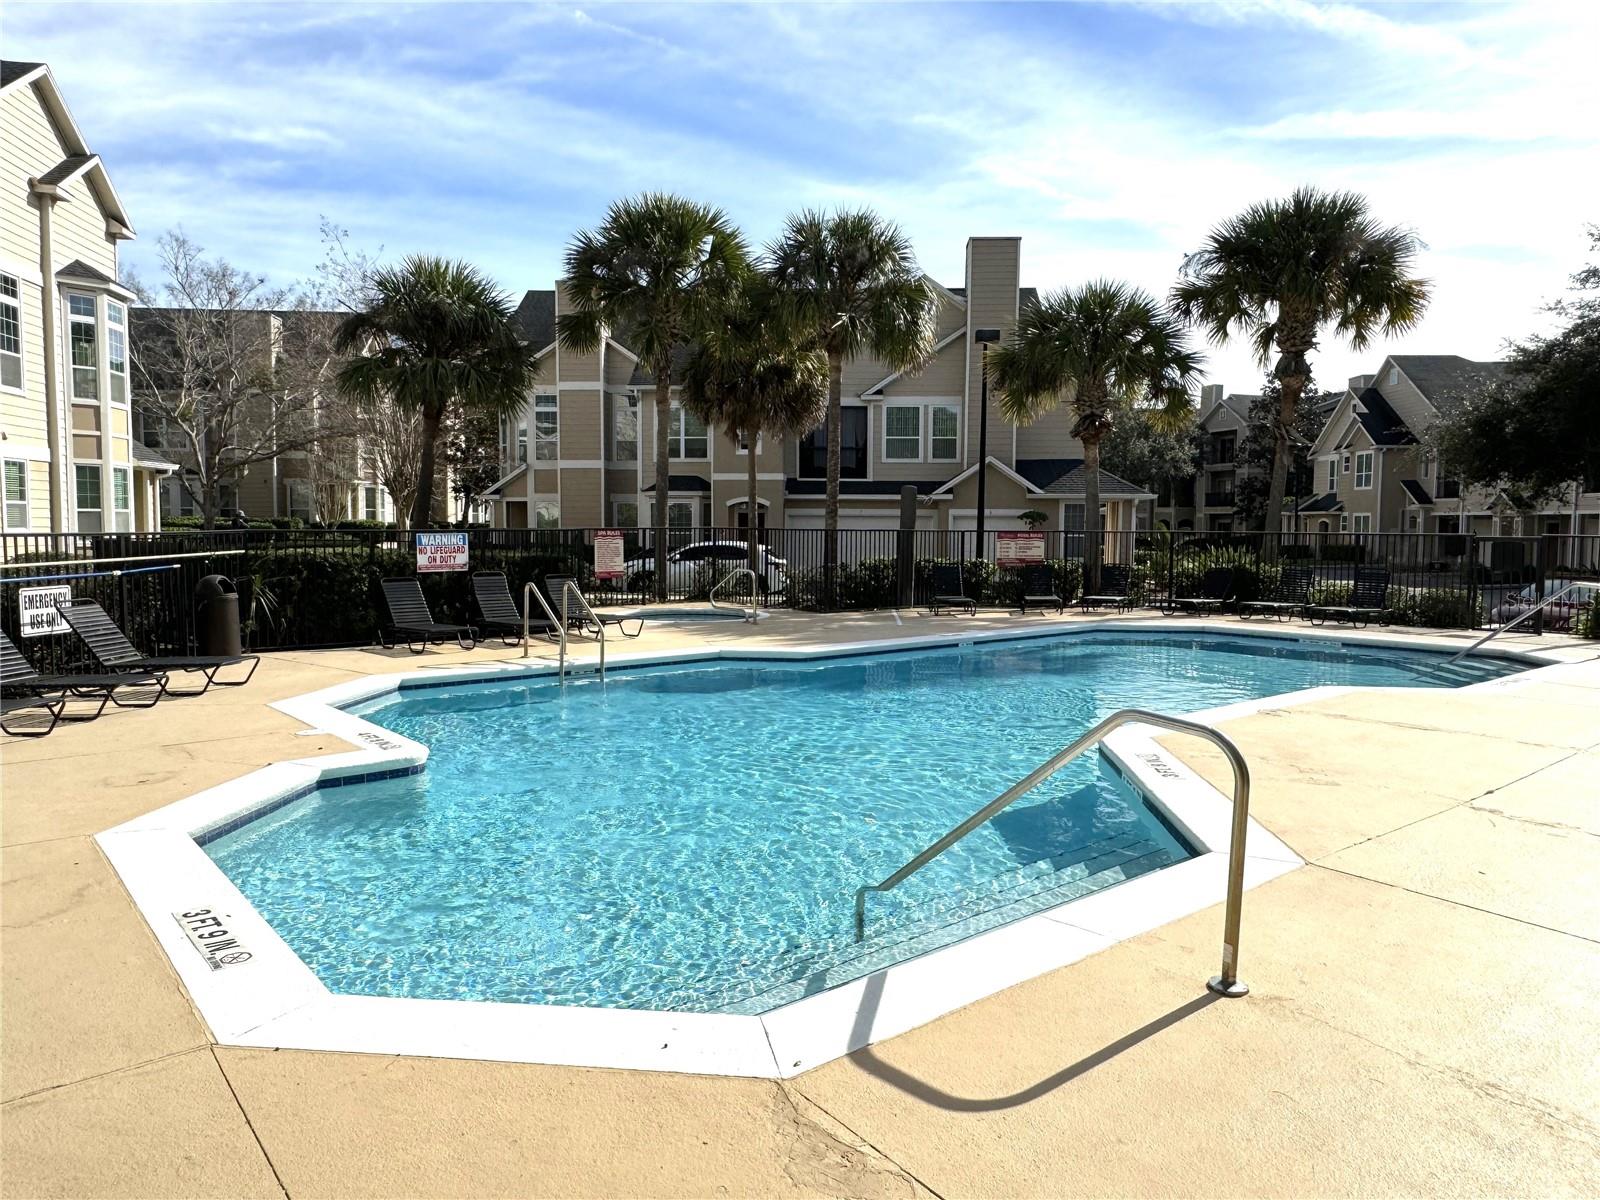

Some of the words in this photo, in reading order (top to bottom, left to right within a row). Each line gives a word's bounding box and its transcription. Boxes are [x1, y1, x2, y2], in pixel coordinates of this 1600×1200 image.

[421, 535, 464, 546] WARNING
[418, 547, 428, 555] NO
[430, 545, 466, 554] LIFEGUARD
[440, 555, 457, 563] DUTY
[23, 591, 67, 610] EMERGENCY
[30, 613, 45, 629] USE
[181, 909, 212, 918] 3
[197, 929, 229, 940] 9
